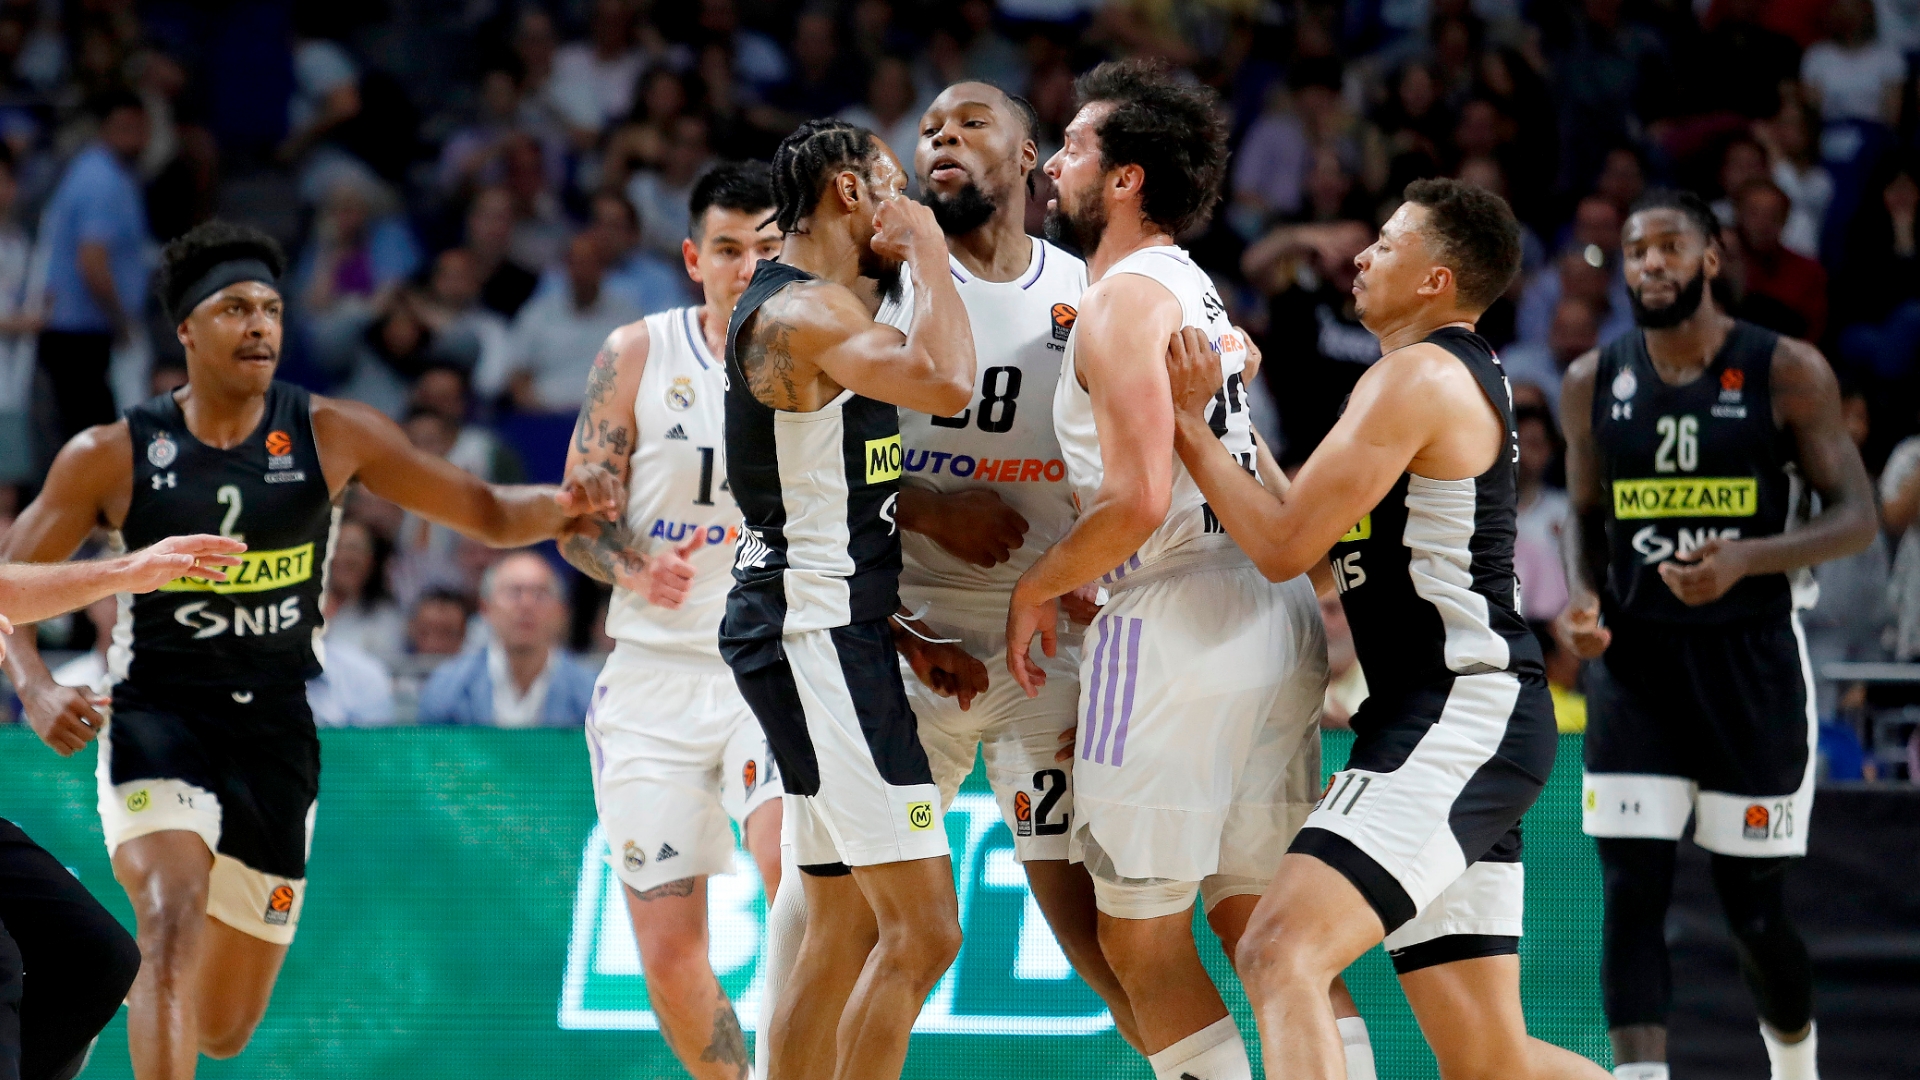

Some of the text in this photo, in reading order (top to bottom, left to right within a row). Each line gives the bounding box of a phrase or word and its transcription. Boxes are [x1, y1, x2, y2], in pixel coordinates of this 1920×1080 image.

[902, 448, 1065, 482] UTOHERO
[1655, 416, 1698, 472] 26
[217, 485, 243, 543] 2
[1620, 485, 1750, 510] MOZZART
[234, 596, 300, 637] NIS
[1032, 768, 1073, 836] 2
[1327, 773, 1371, 816] 11
[1773, 802, 1793, 839] 26
